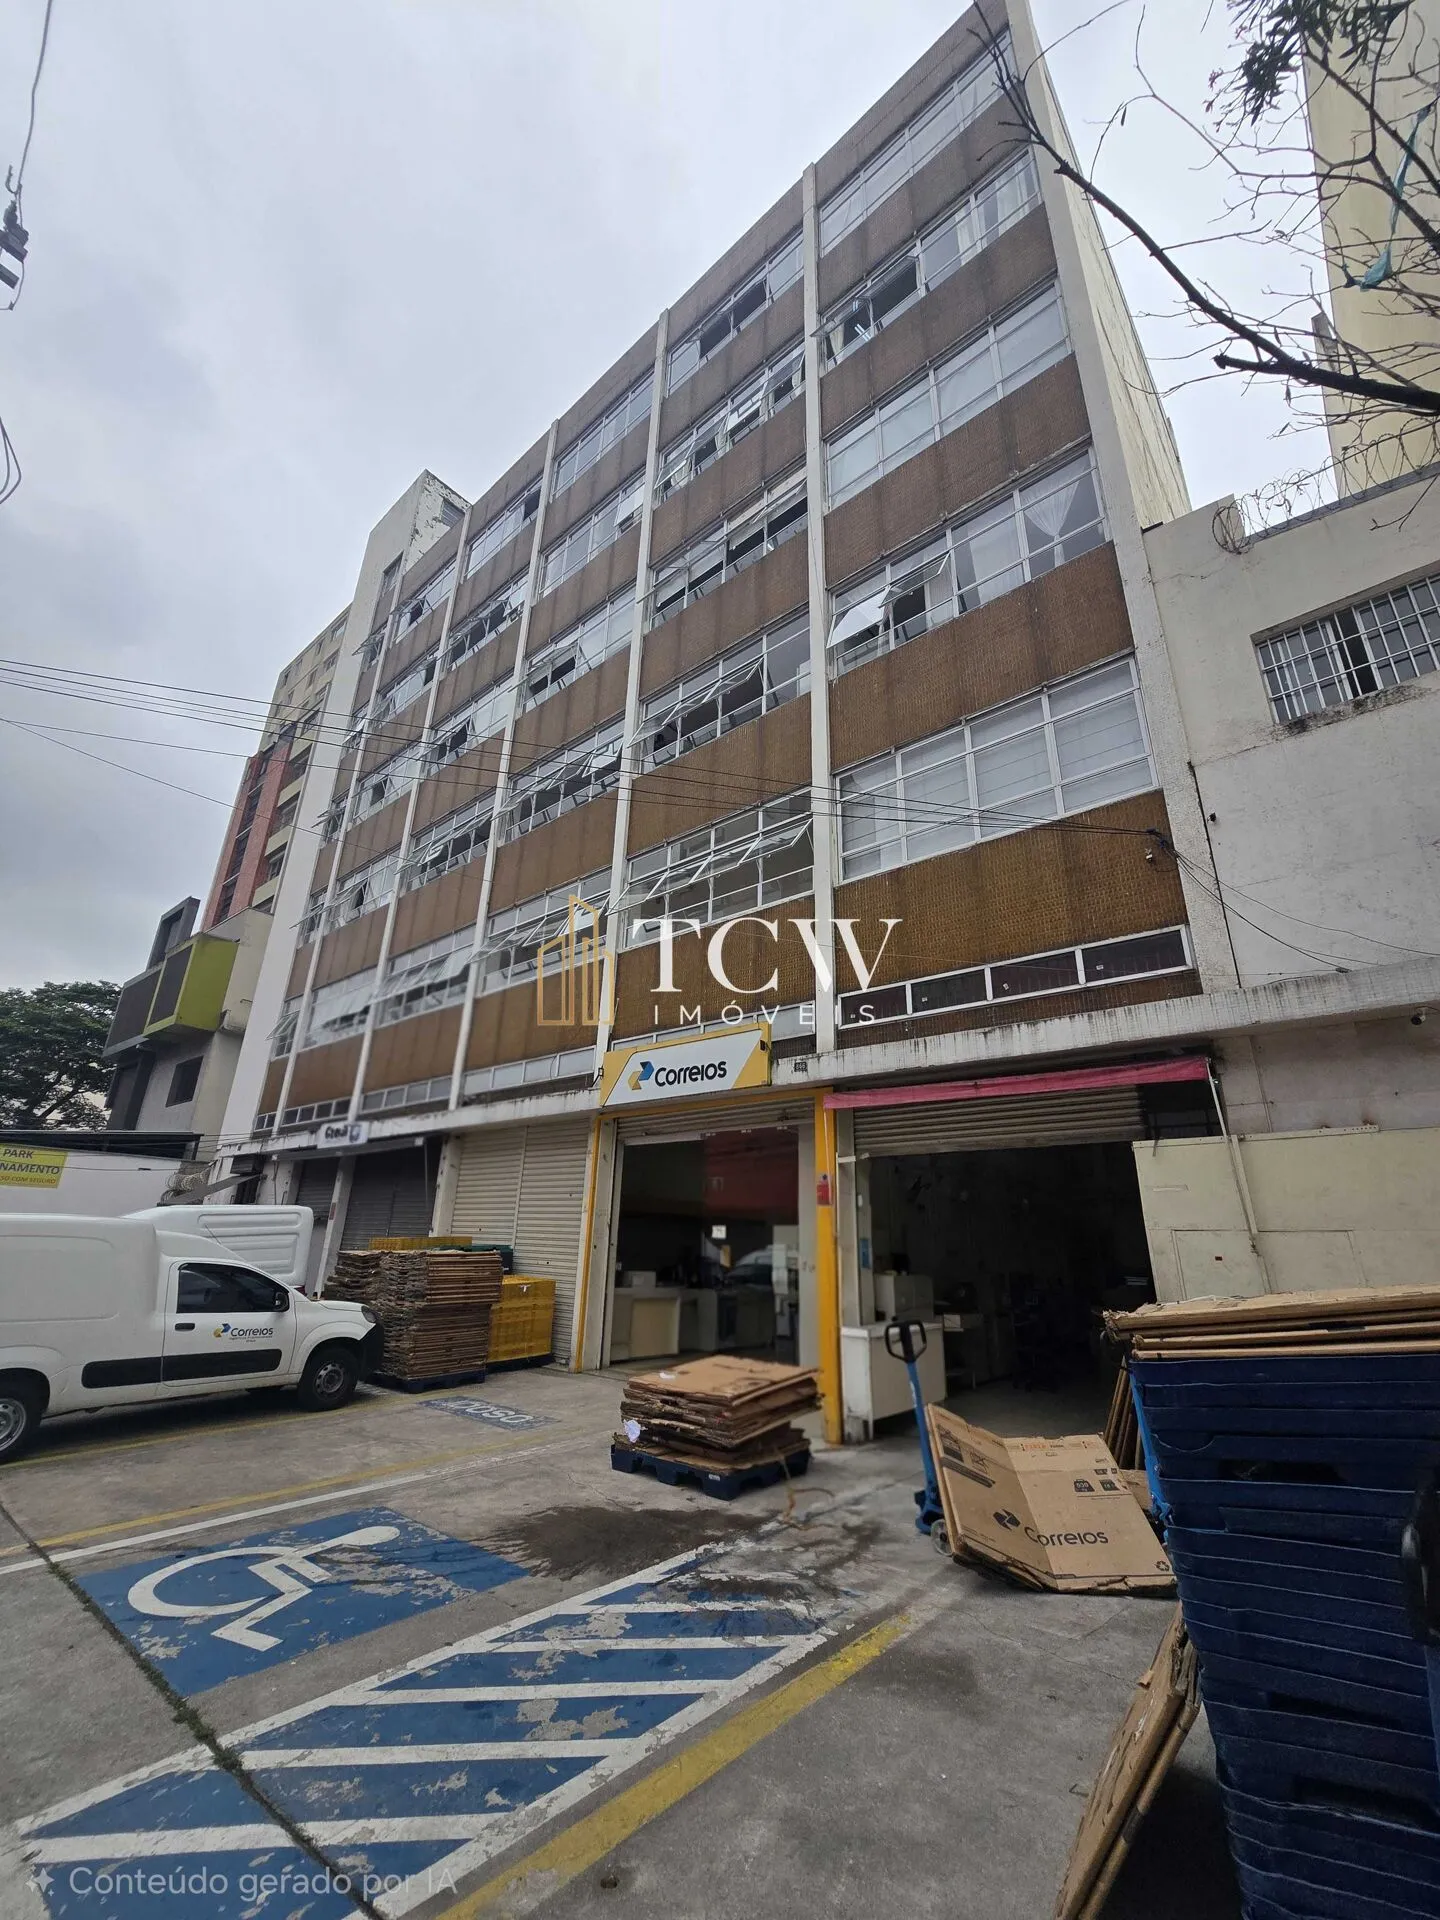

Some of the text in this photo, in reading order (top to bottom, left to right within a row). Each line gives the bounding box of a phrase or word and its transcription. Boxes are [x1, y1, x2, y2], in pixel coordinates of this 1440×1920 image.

[654, 1060, 728, 1088] Correios
[3, 1148, 34, 1160] PARK
[230, 1327, 274, 1338] Correios
[1023, 1526, 1109, 1548] Correios
